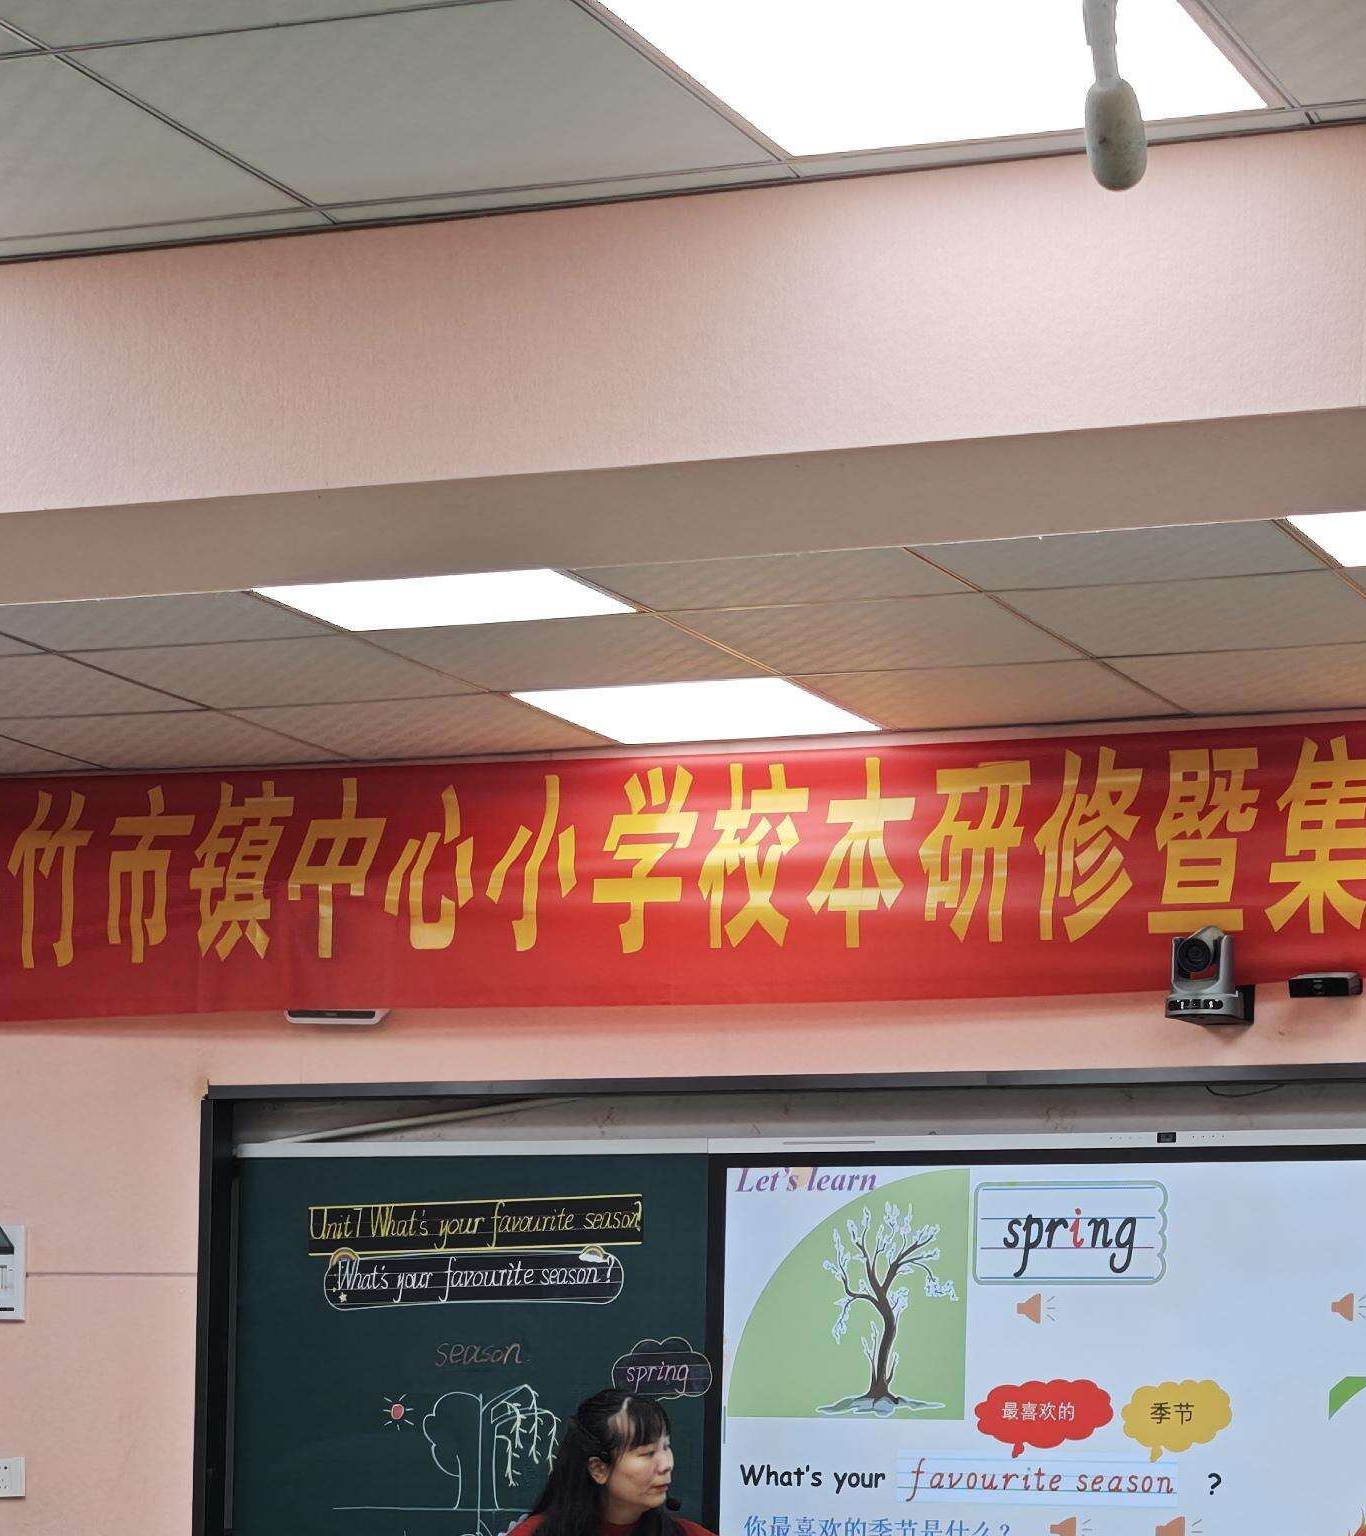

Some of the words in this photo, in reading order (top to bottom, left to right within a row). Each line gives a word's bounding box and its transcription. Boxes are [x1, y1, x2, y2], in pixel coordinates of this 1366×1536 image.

[735, 1167, 798, 1192] Let's
[807, 1167, 877, 1191] learn
[371, 1206, 429, 1237] What's
[434, 1217, 485, 1250] your
[487, 1200, 575, 1249] favourite
[1003, 1208, 1137, 1278] spring
[338, 1258, 389, 1290] What's
[393, 1272, 433, 1303] your
[438, 1256, 534, 1302] favourite
[435, 1342, 524, 1367] season
[626, 1361, 689, 1395] spring
[1001, 1401, 1075, 1422] 最喜欢的
[1149, 1401, 1195, 1425] 季节
[739, 1463, 823, 1488] What's
[833, 1471, 886, 1495] your
[905, 1457, 1062, 1502] favourite
[1075, 1474, 1174, 1495] season
